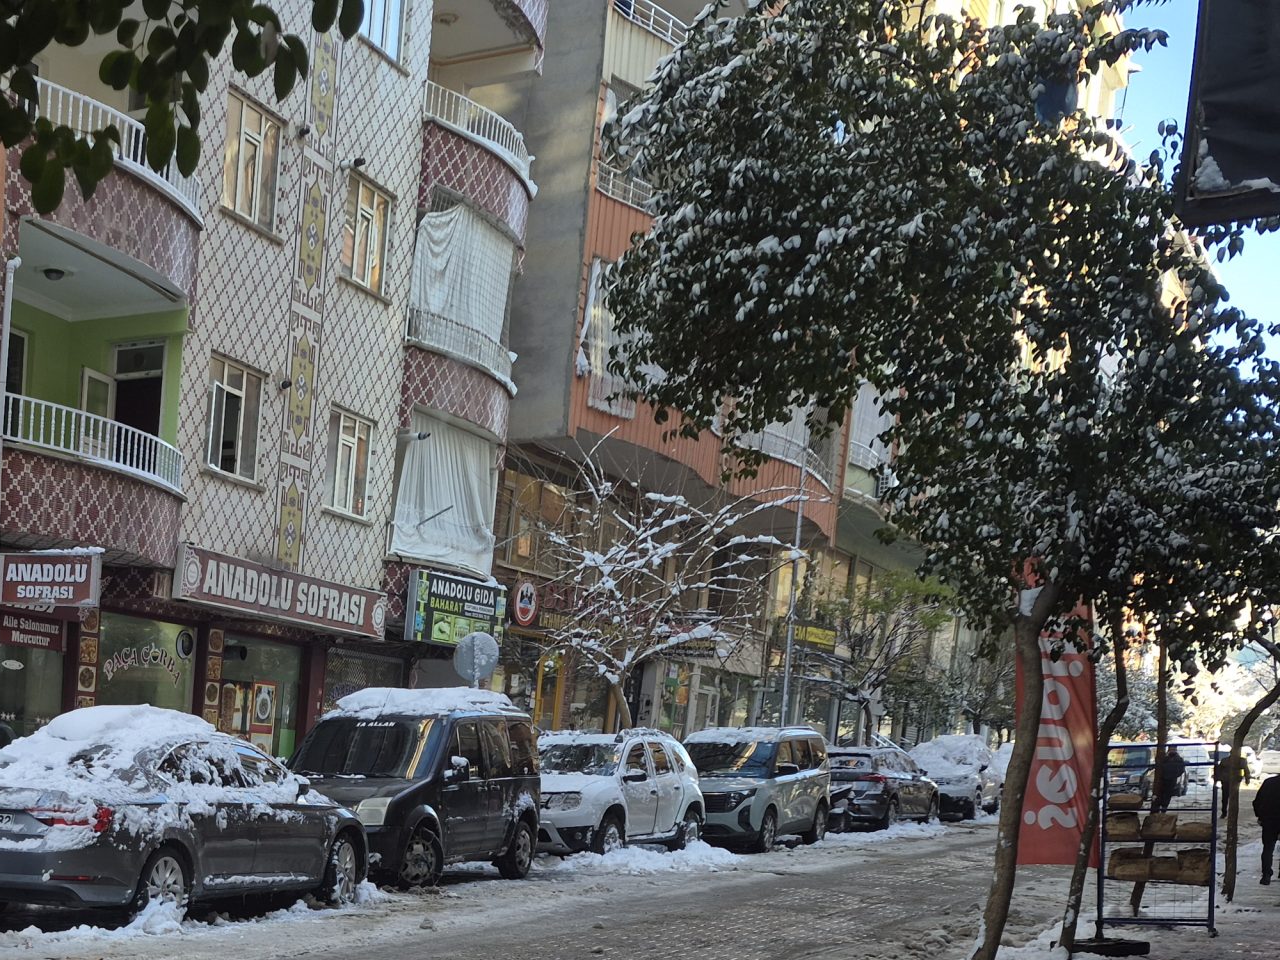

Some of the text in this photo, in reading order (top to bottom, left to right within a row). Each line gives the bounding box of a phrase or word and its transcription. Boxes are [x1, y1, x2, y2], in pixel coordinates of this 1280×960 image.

[6, 563, 88, 583] ANADOLU
[16, 585, 74, 600] SOFRASI
[202, 559, 367, 626] ANADOLU SOFRASI
[431, 578, 495, 606] ANADOLU GIDA
[430, 596, 463, 613] BAHARAT
[3, 615, 60, 635] Aile Salonumuz
[11, 630, 52, 647] Mevcuttur
[103, 647, 140, 681] PAÇA
